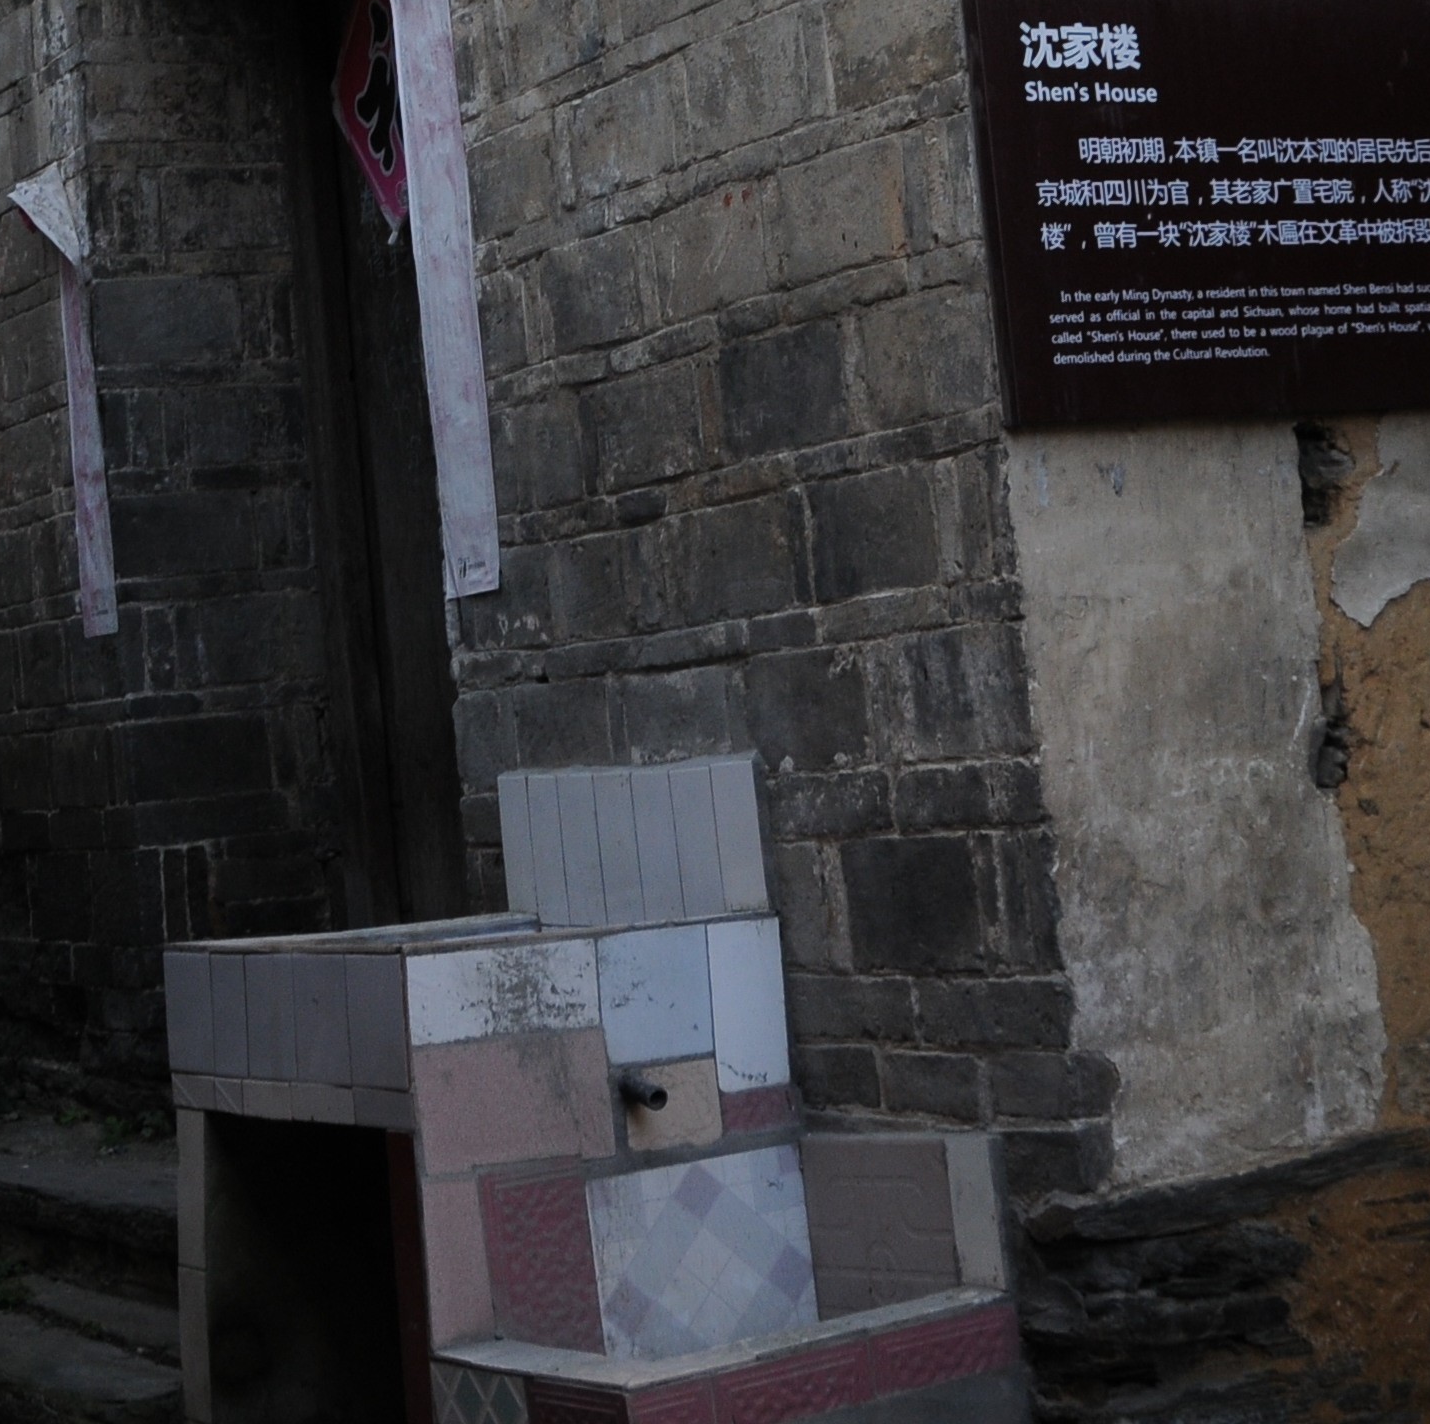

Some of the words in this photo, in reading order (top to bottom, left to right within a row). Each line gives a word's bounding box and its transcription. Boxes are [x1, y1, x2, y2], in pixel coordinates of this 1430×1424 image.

[1019, 21, 1142, 71] 沈家楼
[1024, 80, 1090, 102] Shen's
[1094, 82, 1158, 103] House
[1061, 290, 1071, 302] In
[1074, 290, 1091, 302] the
[1094, 289, 1119, 304] early
[1122, 288, 1149, 303] Ming
[1197, 290, 1203, 298] a
[1206, 286, 1246, 298] resident
[1248, 286, 1258, 297] in
[1260, 285, 1278, 297] this
[1280, 285, 1305, 296] town
[1308, 284, 1340, 296] named
[1343, 283, 1367, 295] Shen
[1369, 282, 1394, 294] Bensi
[1396, 282, 1414, 294] had
[1049, 311, 1084, 324] served
[1090, 313, 1101, 323] as
[1106, 309, 1140, 322] official
[1145, 309, 1155, 320] in
[1160, 309, 1177, 320] the
[1182, 307, 1215, 321] capital
[1220, 306, 1238, 318] and
[1288, 304, 1319, 316] whose
[1324, 304, 1352, 315] home
[1356, 303, 1374, 314] had
[1378, 302, 1400, 313] built
[1051, 331, 1082, 344] called
[1171, 328, 1197, 340] there
[1201, 327, 1225, 339] used
[1229, 327, 1240, 338] to
[1243, 326, 1256, 337] be
[1260, 328, 1266, 337] a
[1270, 325, 1297, 337] wood
[1338, 323, 1348, 334] of
[1053, 351, 1114, 365] demolished
[1117, 349, 1151, 365] during
[1154, 349, 1170, 361] the
[1173, 347, 1212, 360] Cultural
